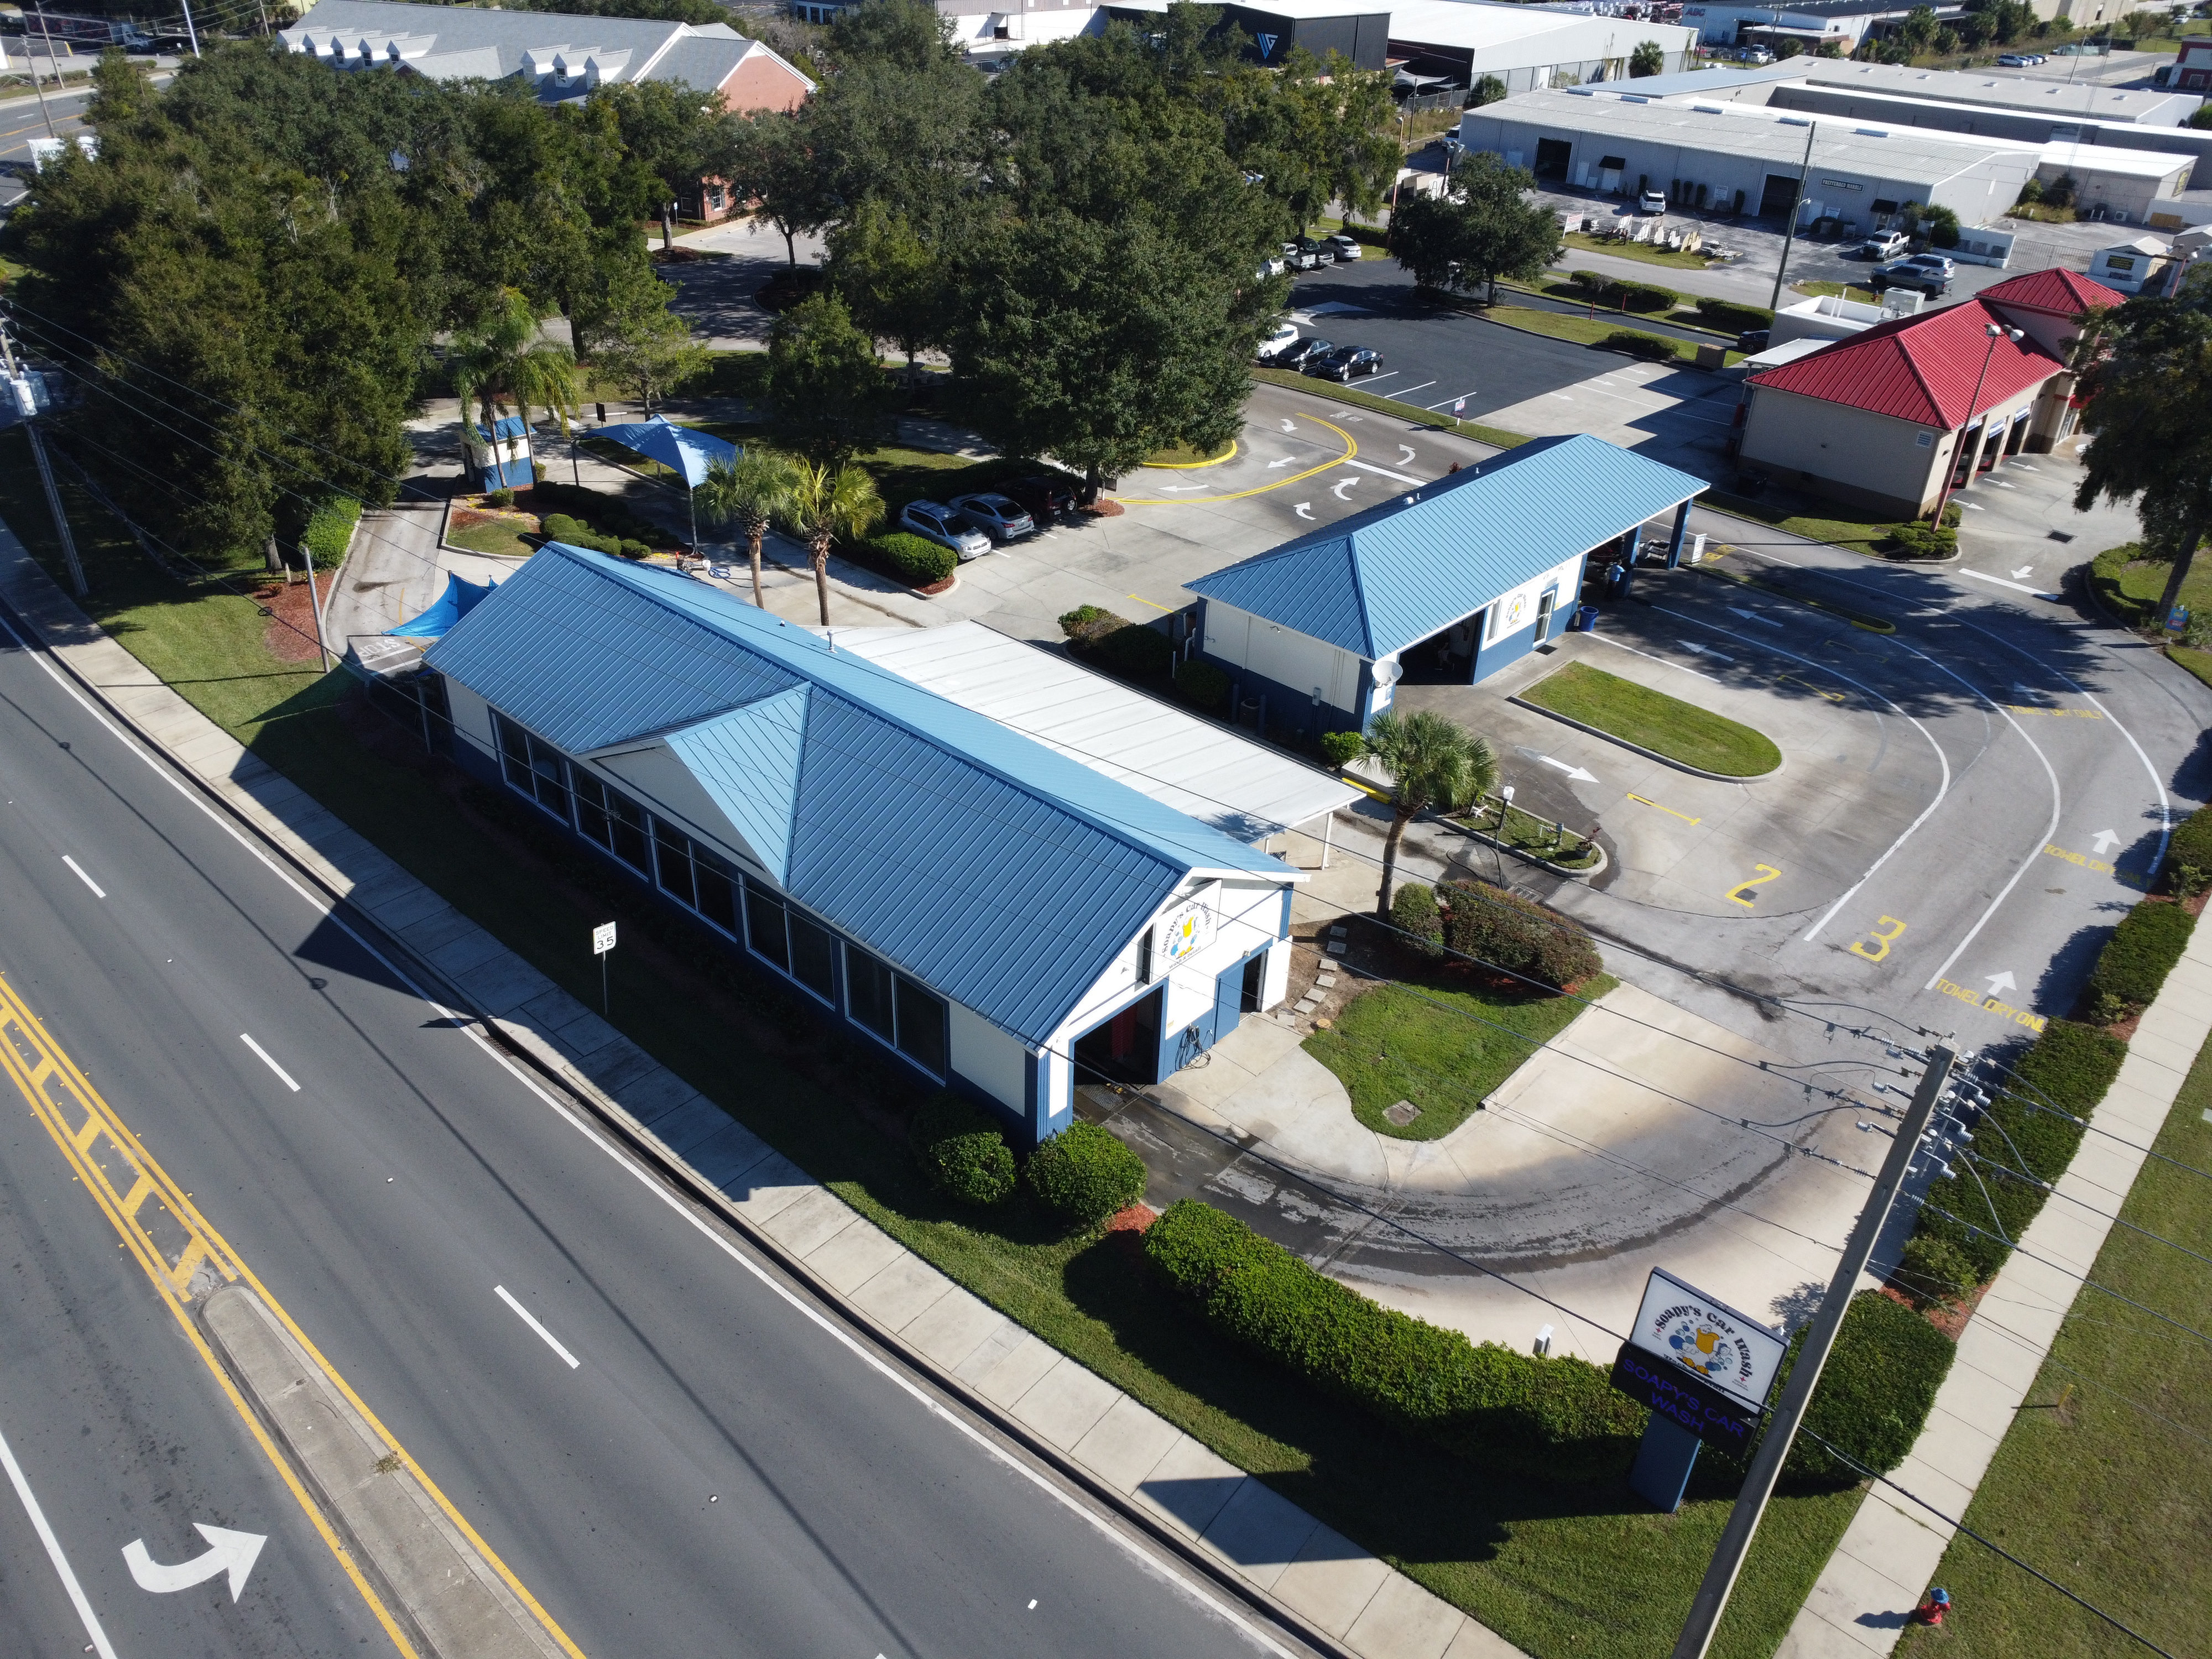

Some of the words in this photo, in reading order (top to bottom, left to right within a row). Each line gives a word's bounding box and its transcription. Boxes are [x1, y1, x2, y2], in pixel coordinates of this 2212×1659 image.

[357, 638, 401, 657] STOP
[2044, 843, 2086, 867] TOWEL
[1724, 863, 1782, 908] 2
[596, 925, 613, 935] SPEED
[597, 936, 614, 950] 35
[598, 931, 612, 940] LIMIT
[1850, 915, 1907, 962] 3
[1936, 978, 1980, 1006] TOWEL
[1983, 999, 2018, 1019] DRY
[2015, 1011, 2045, 1034] ONL
[1655, 1305, 1702, 1330] Soapy's
[1707, 1312, 1735, 1335] Car
[1734, 1337, 1753, 1378] Wash
[1623, 1359, 1700, 1411] SOAPY'S
[1704, 1407, 1744, 1437] CAR
[1652, 1391, 1704, 1431] WASH
